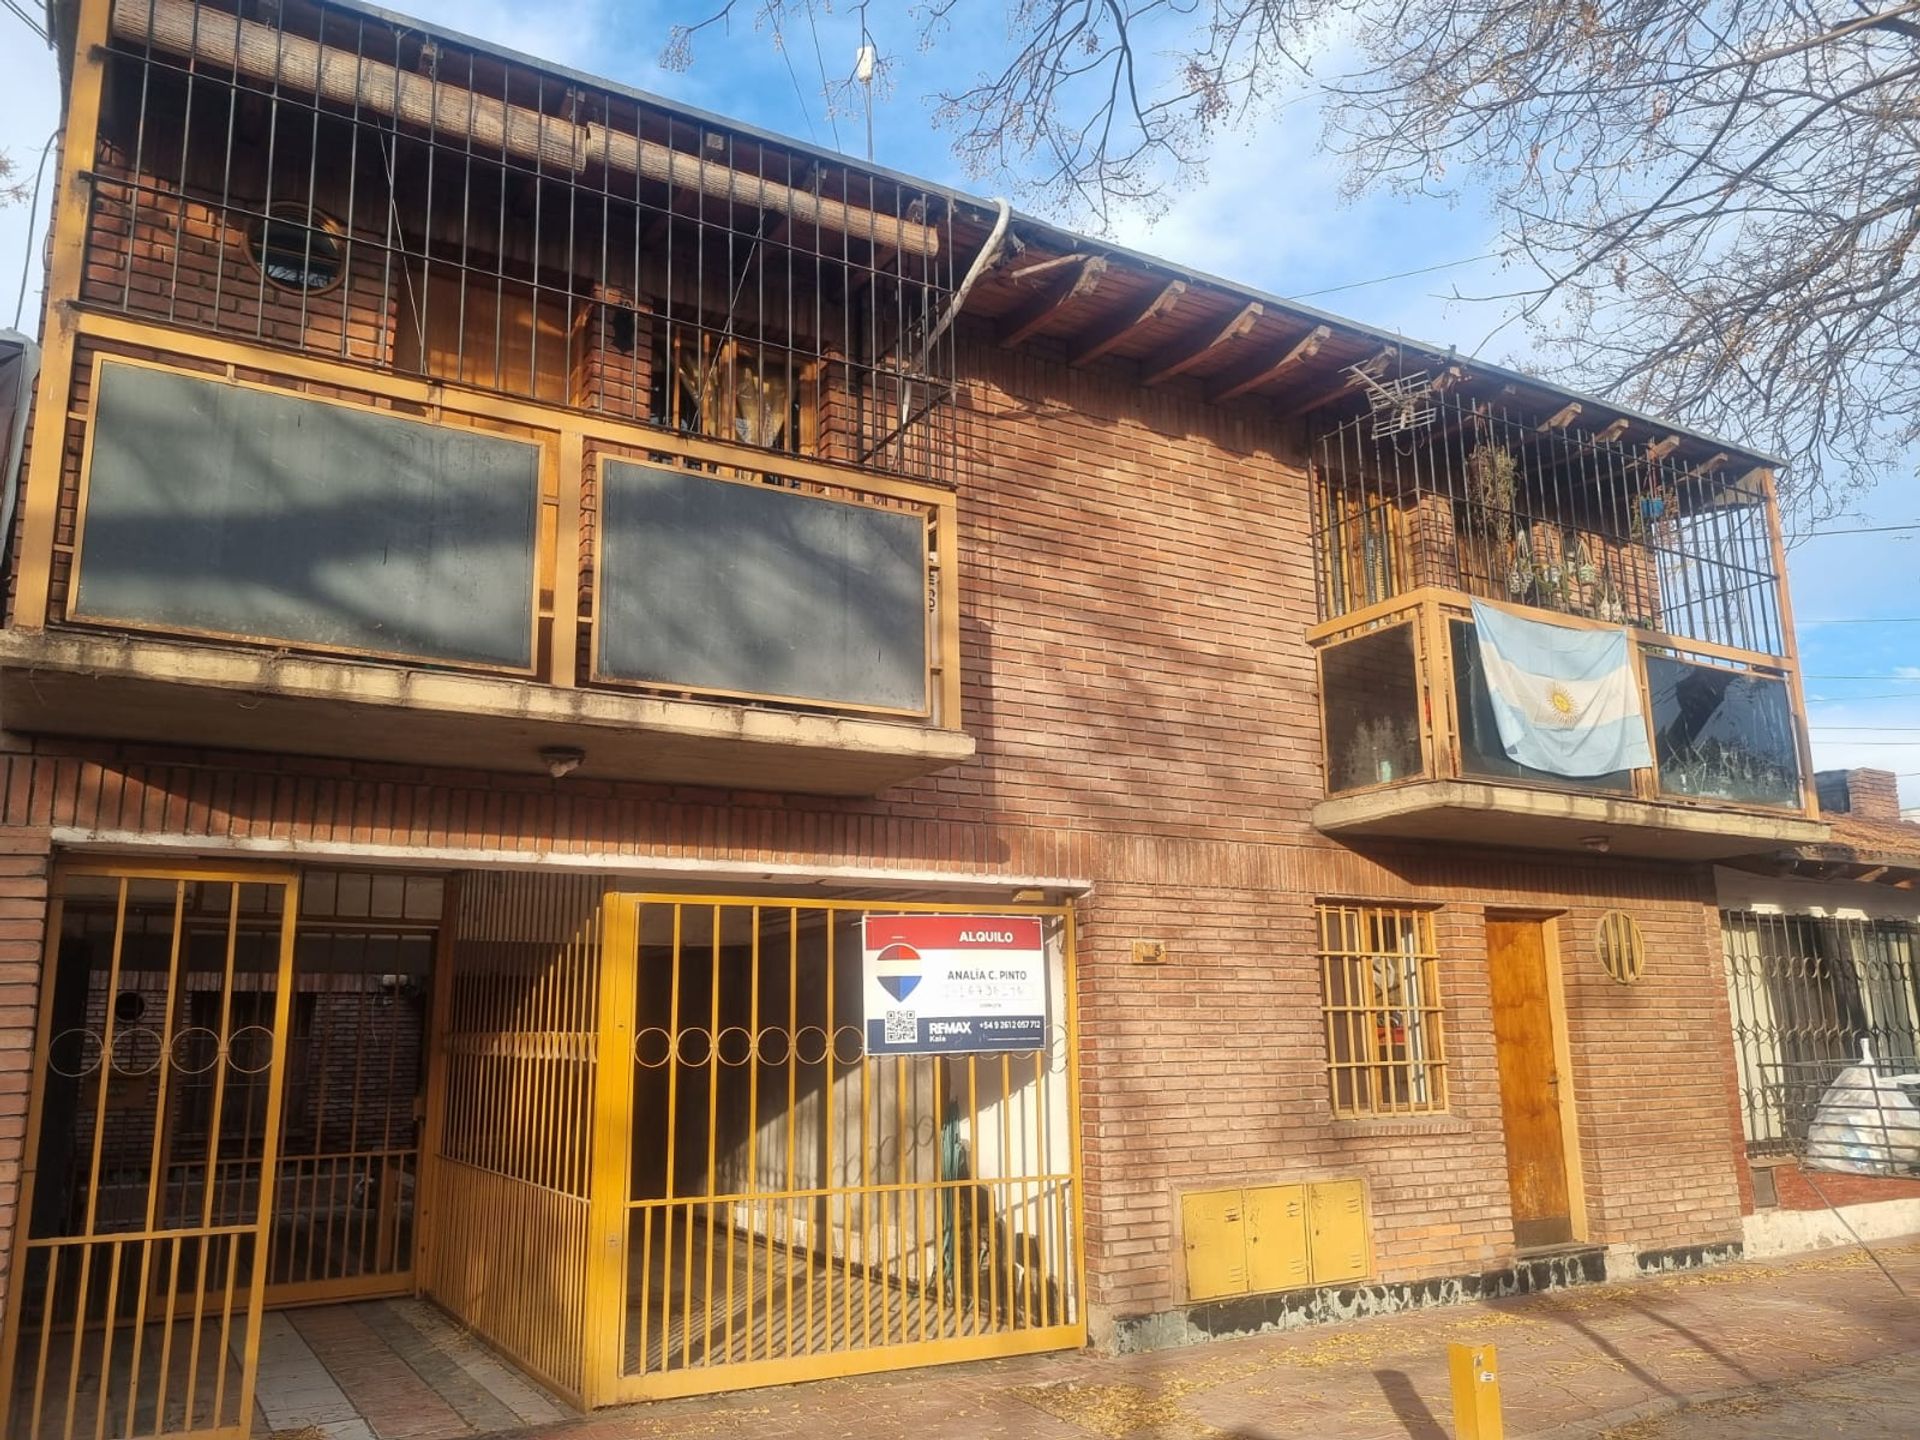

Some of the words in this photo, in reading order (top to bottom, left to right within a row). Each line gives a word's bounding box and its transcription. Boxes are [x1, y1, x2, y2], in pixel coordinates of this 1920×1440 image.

[959, 931, 1013, 943] ALQUILO
[947, 968, 986, 980] ANALÍA
[988, 970, 998, 980] C.
[999, 970, 1027, 980] PINTO
[979, 1020, 993, 1029] +54
[994, 1020, 999, 1029] 9
[1030, 1020, 1040, 1028] 712
